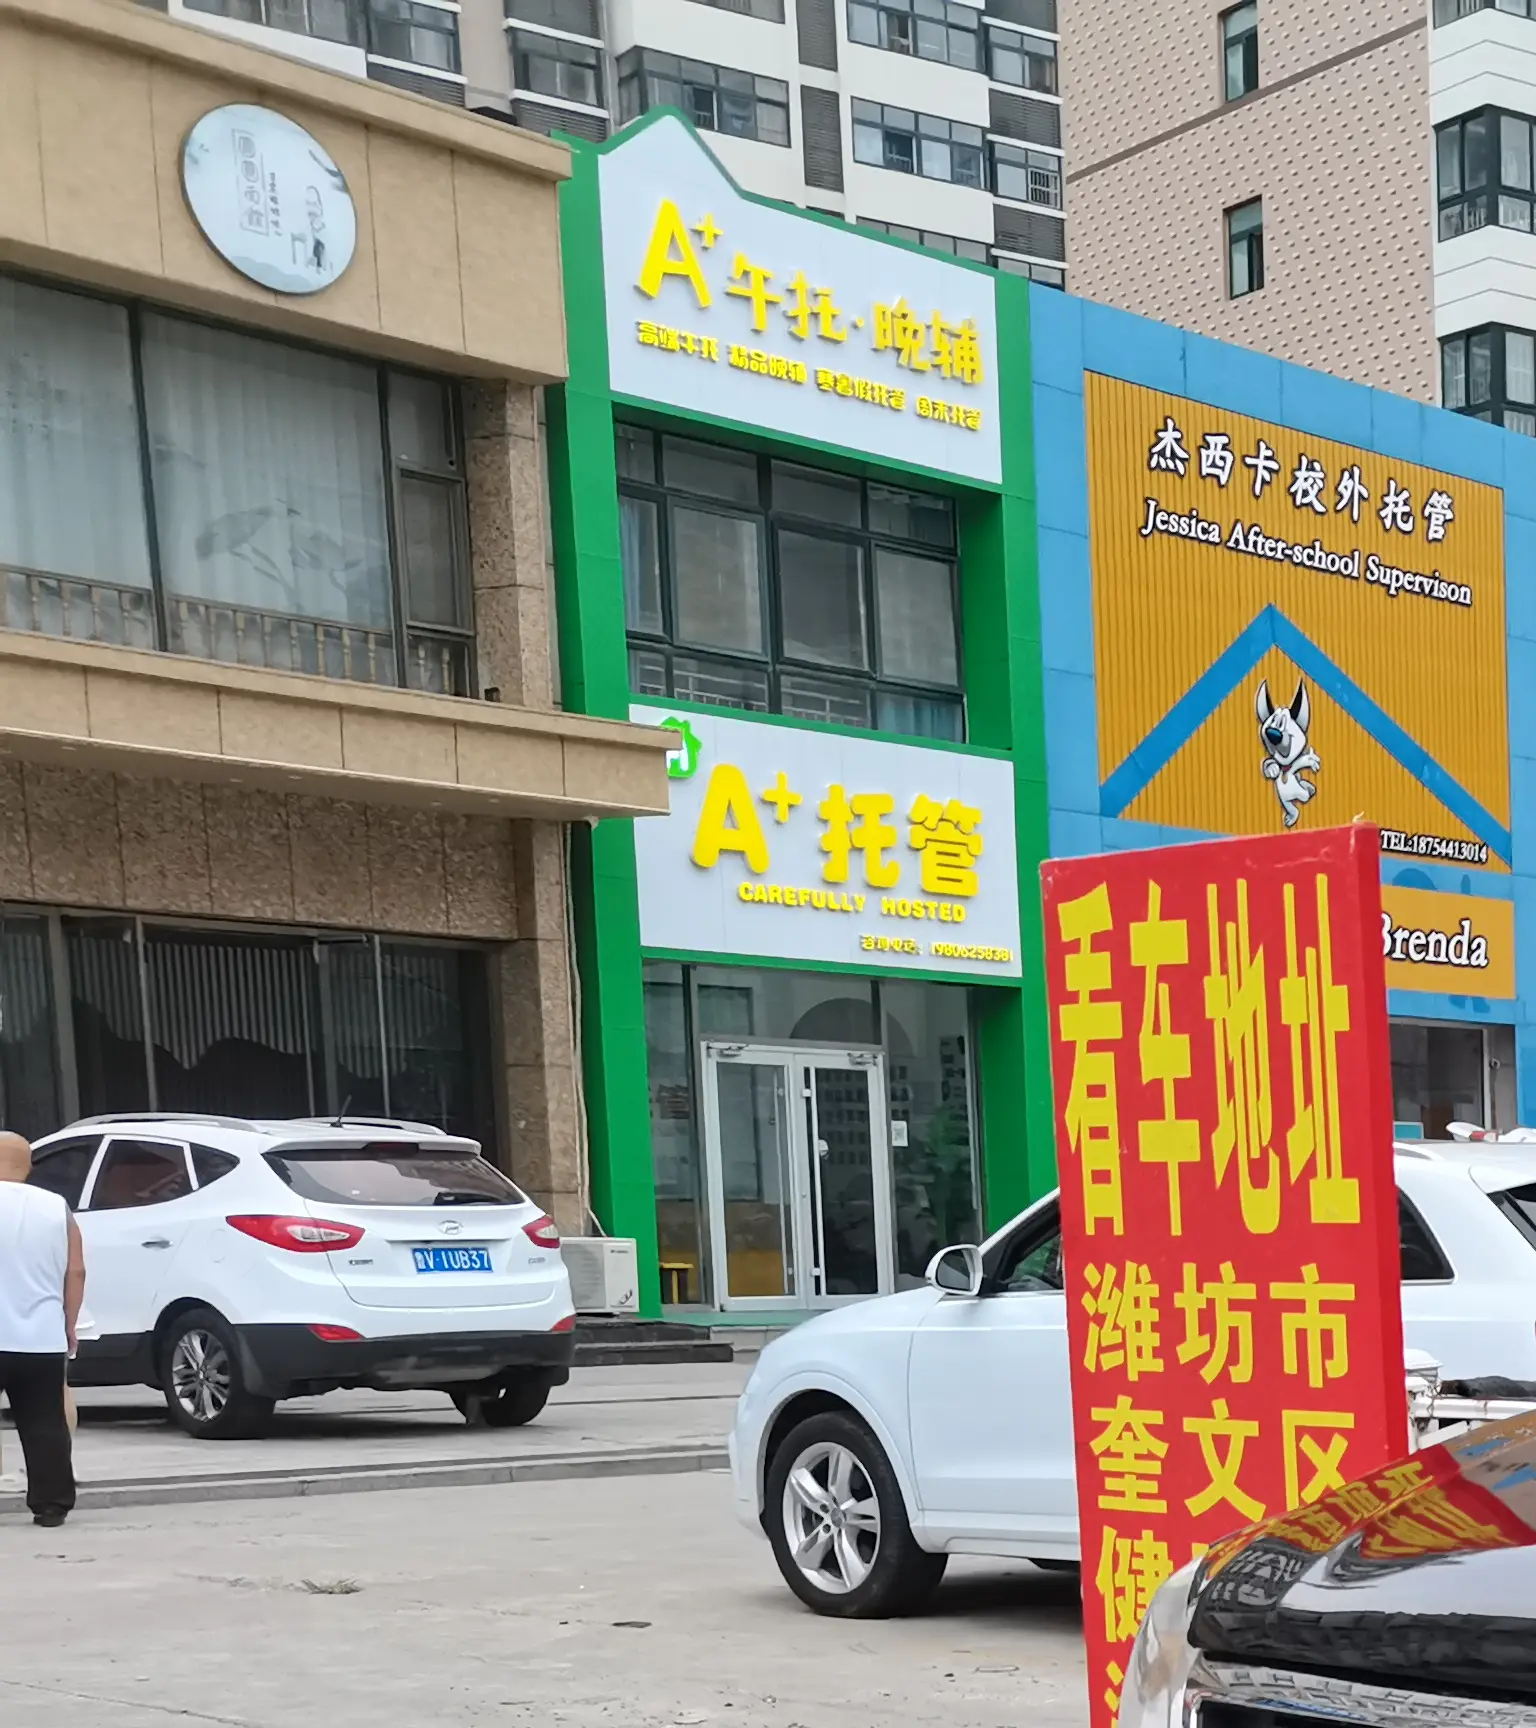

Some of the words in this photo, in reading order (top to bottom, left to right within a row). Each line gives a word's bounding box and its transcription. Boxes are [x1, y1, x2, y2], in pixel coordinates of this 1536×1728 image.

[637, 320, 719, 361] 高端午托
[1148, 418, 1456, 542] 杰西卡校外托管
[1141, 500, 1221, 545] Jessica
[1226, 520, 1361, 580] After-school
[1365, 556, 1474, 609] Supervison
[738, 881, 867, 913] CAREFULLY
[881, 896, 967, 922] HOSTED
[1380, 829, 1489, 864] TEL:18754413014
[1058, 873, 1361, 1237] 看车地址
[1081, 1260, 1356, 1389] 潍坊市
[1089, 1396, 1356, 1522] 奎文区
